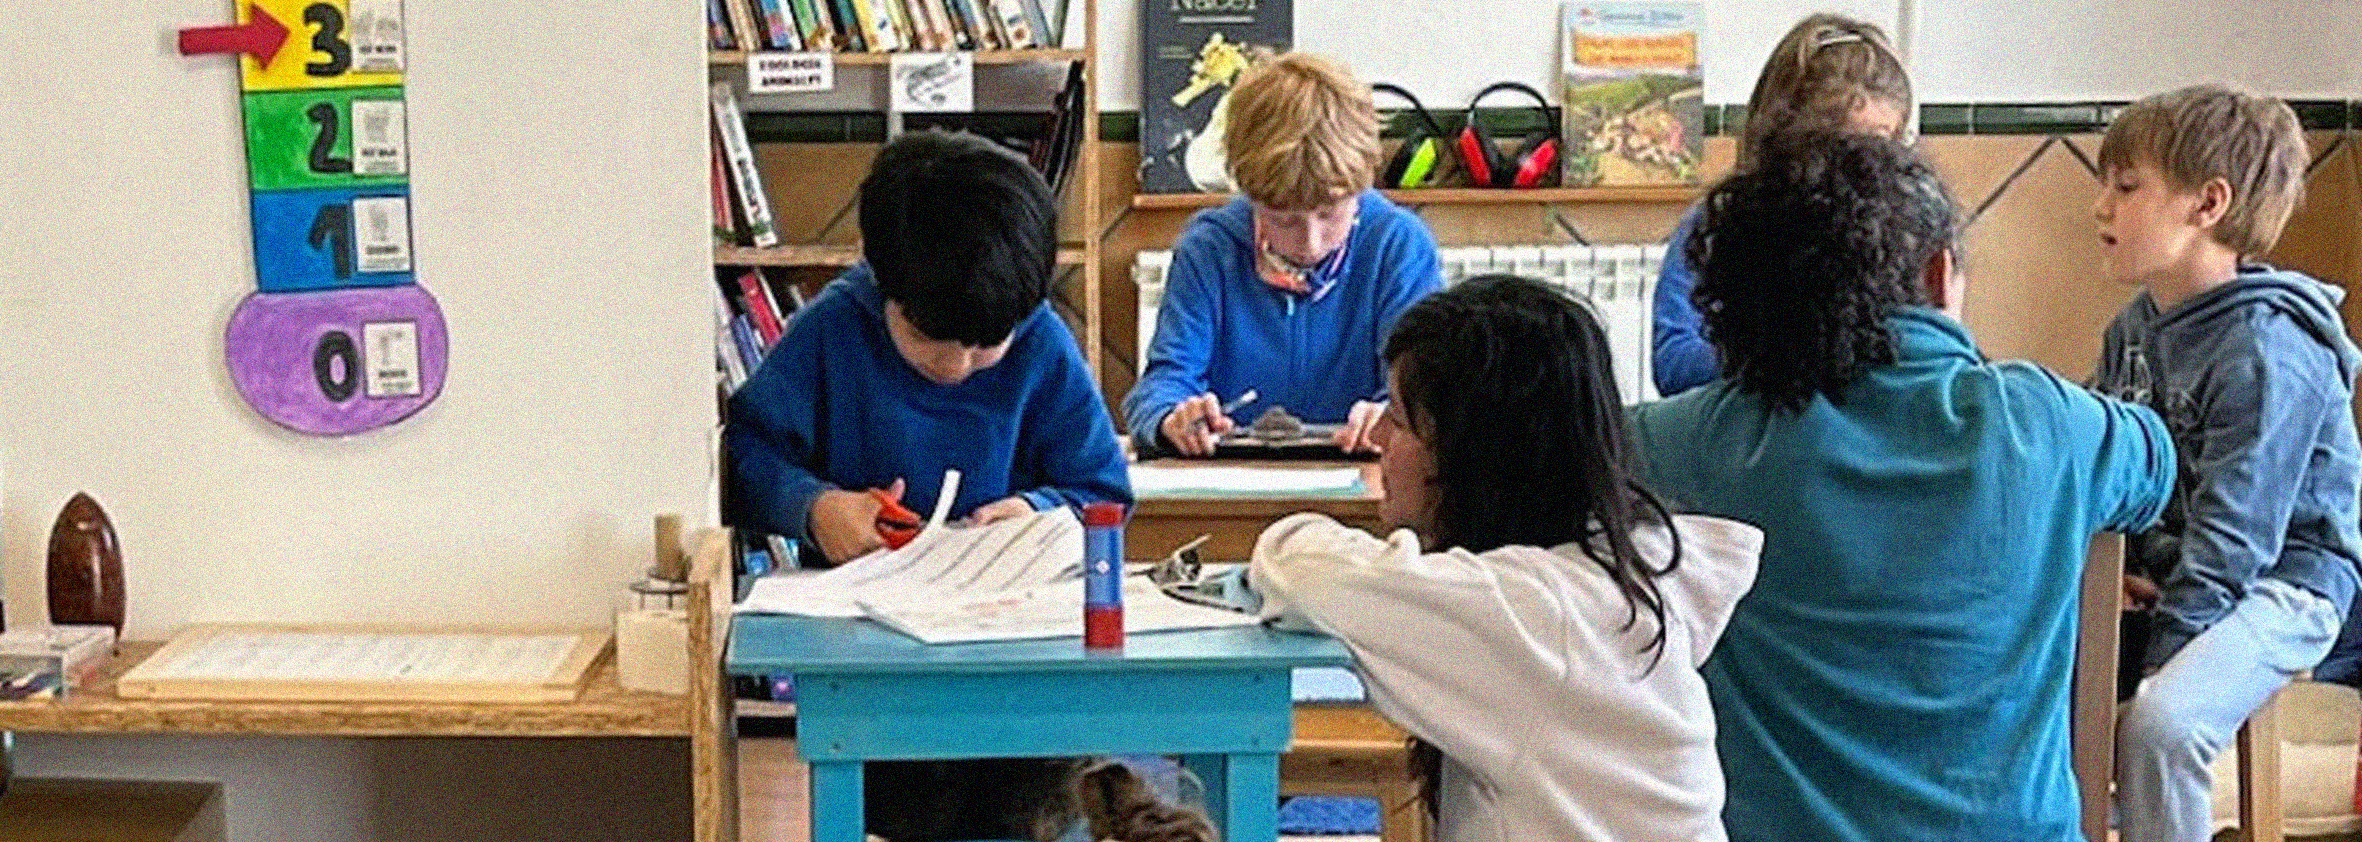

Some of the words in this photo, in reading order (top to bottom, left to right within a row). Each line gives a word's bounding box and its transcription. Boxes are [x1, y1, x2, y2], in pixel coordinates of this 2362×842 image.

[303, 3, 352, 77] 3
[307, 103, 353, 173] 2
[308, 204, 350, 279] 1
[314, 331, 359, 402] 0
